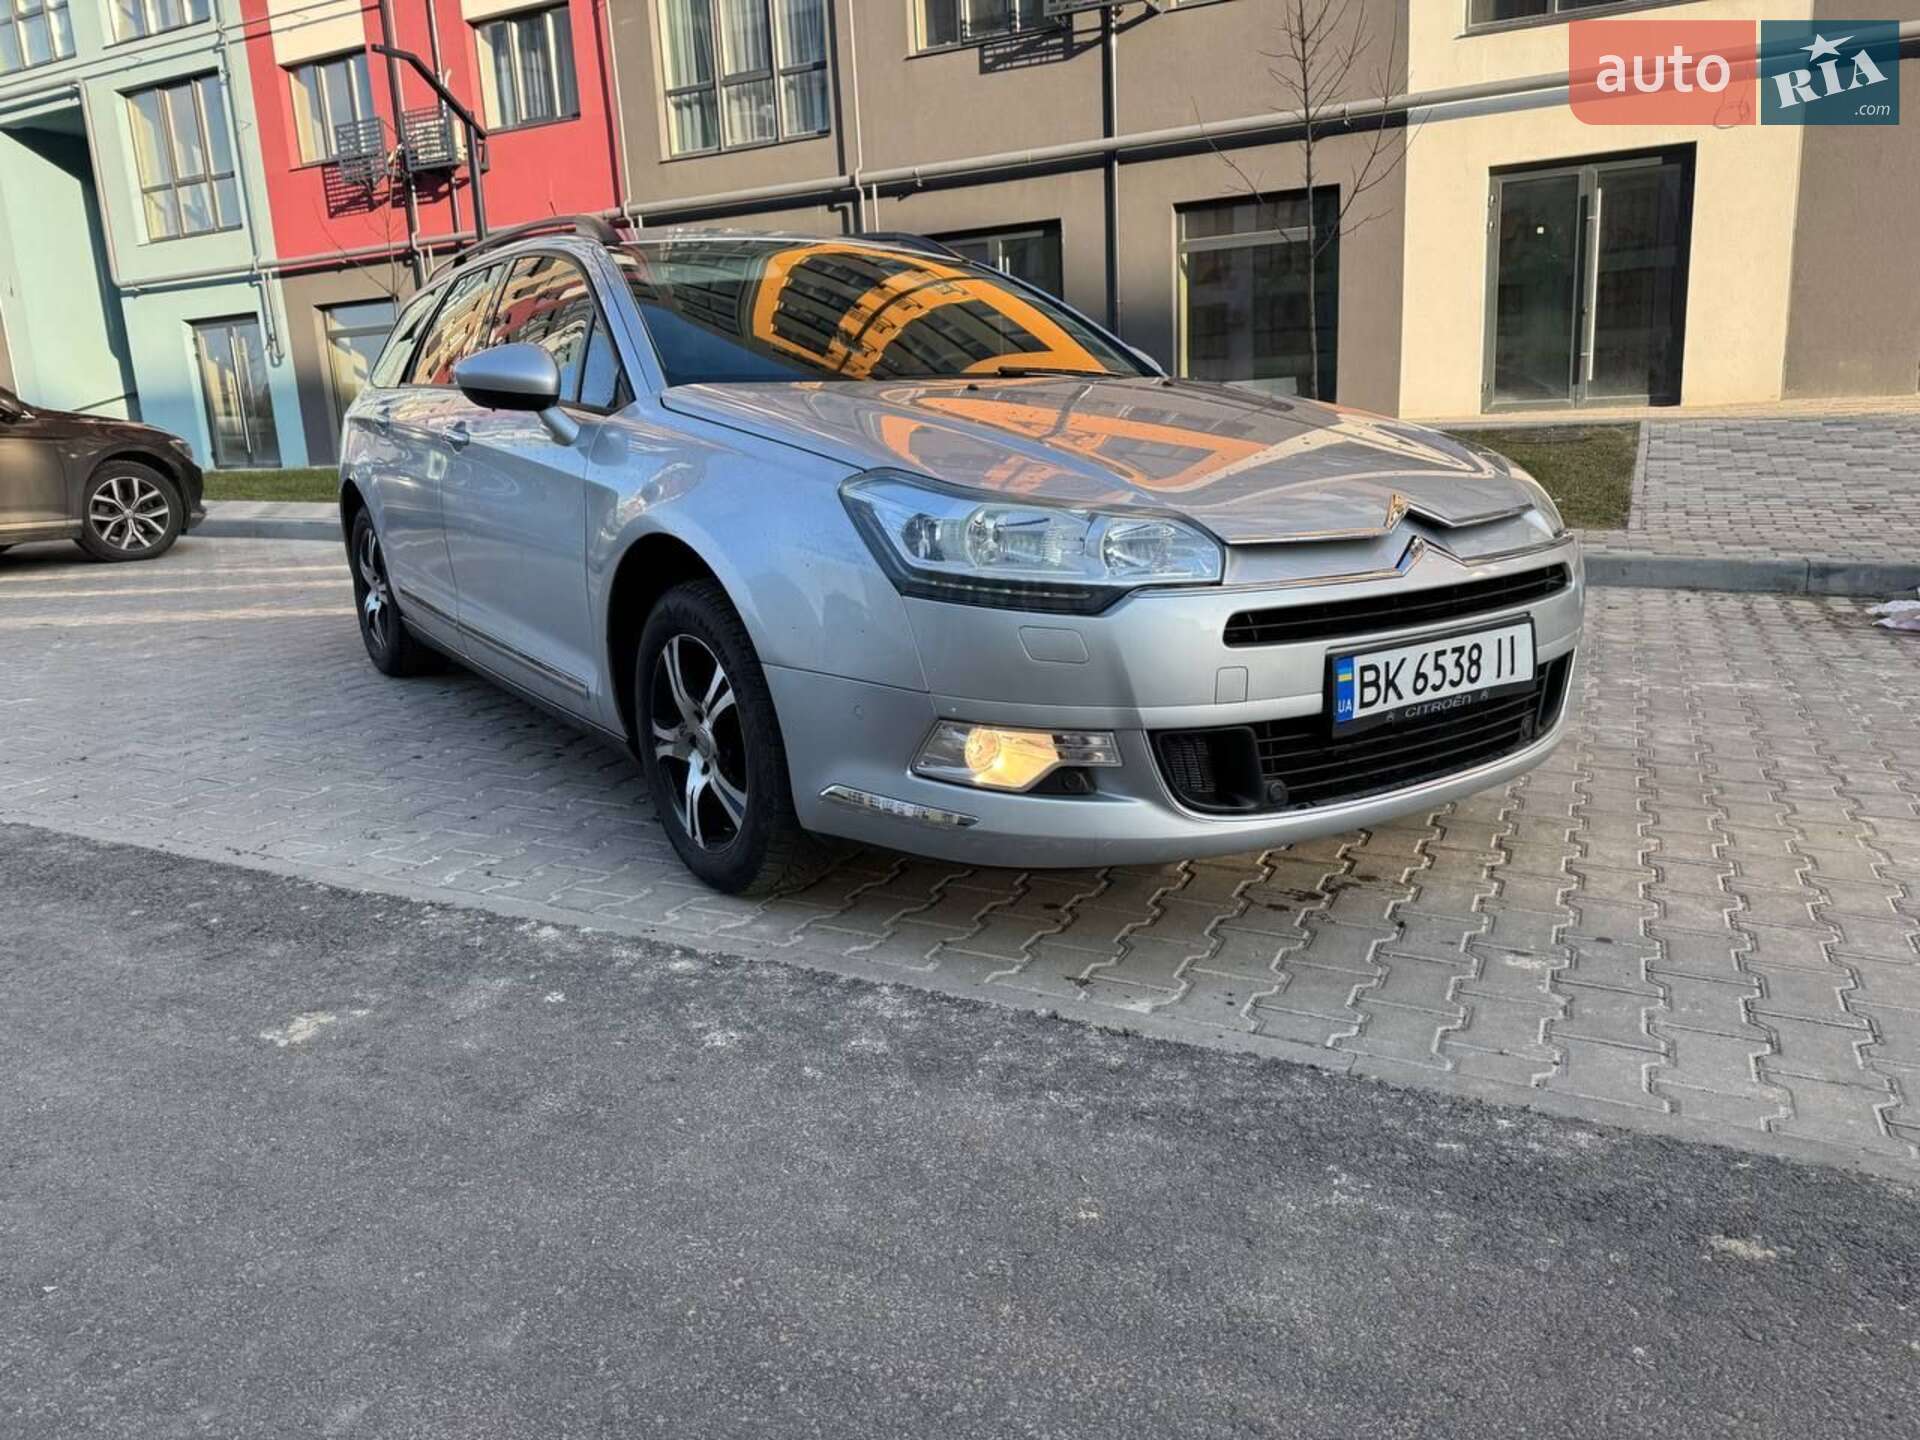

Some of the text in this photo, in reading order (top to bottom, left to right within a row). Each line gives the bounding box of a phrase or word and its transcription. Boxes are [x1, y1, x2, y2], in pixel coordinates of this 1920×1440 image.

[1359, 657, 1407, 709] BK
[1413, 643, 1482, 695] 6538
[1337, 698, 1353, 714] UA
